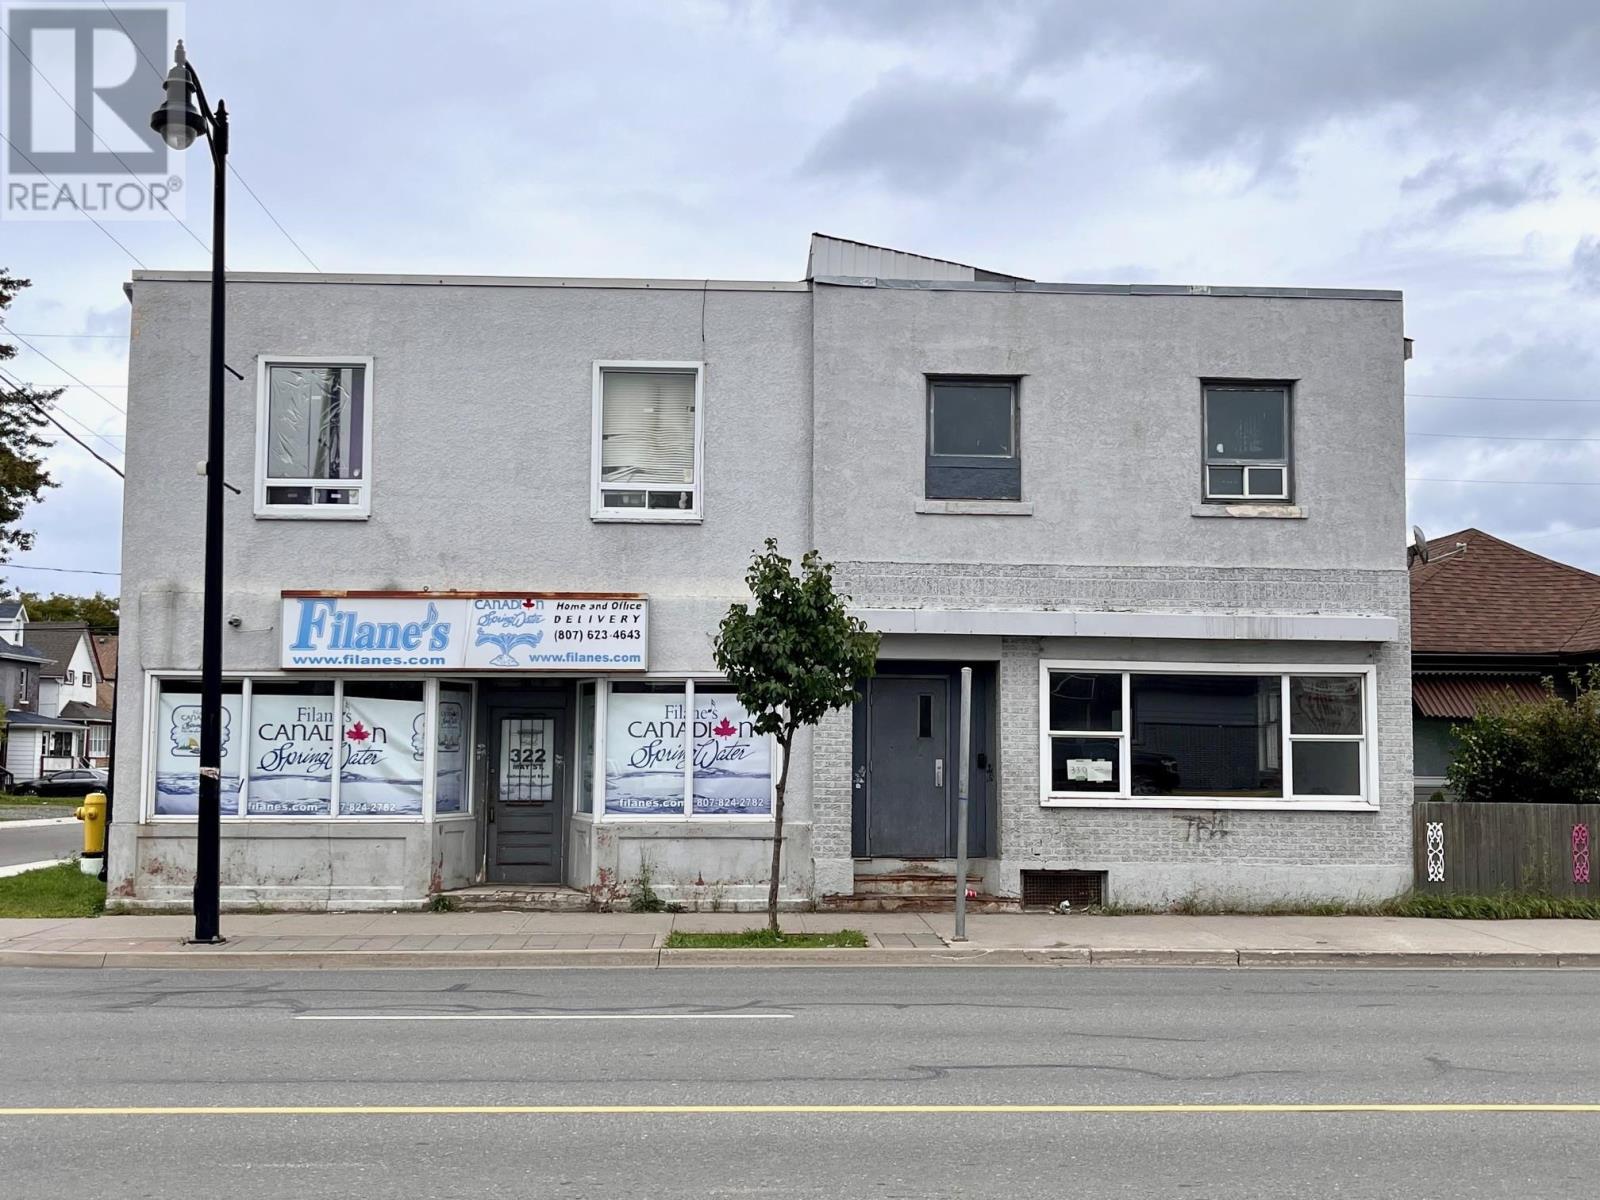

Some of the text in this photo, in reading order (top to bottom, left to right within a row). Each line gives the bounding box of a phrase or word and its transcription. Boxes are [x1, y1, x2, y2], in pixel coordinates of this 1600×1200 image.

[556, 601, 642, 610] Home and Office
[289, 598, 452, 651] Filane's
[554, 615, 641, 623] DELIVERY
[554, 630, 641, 642] (807) 623-4643
[293, 654, 445, 665] www.filanes.com
[529, 652, 641, 663] www.filanes.com
[296, 703, 352, 723] Filan's
[510, 748, 546, 763] 322
[696, 798, 764, 807] 807-824-2782
